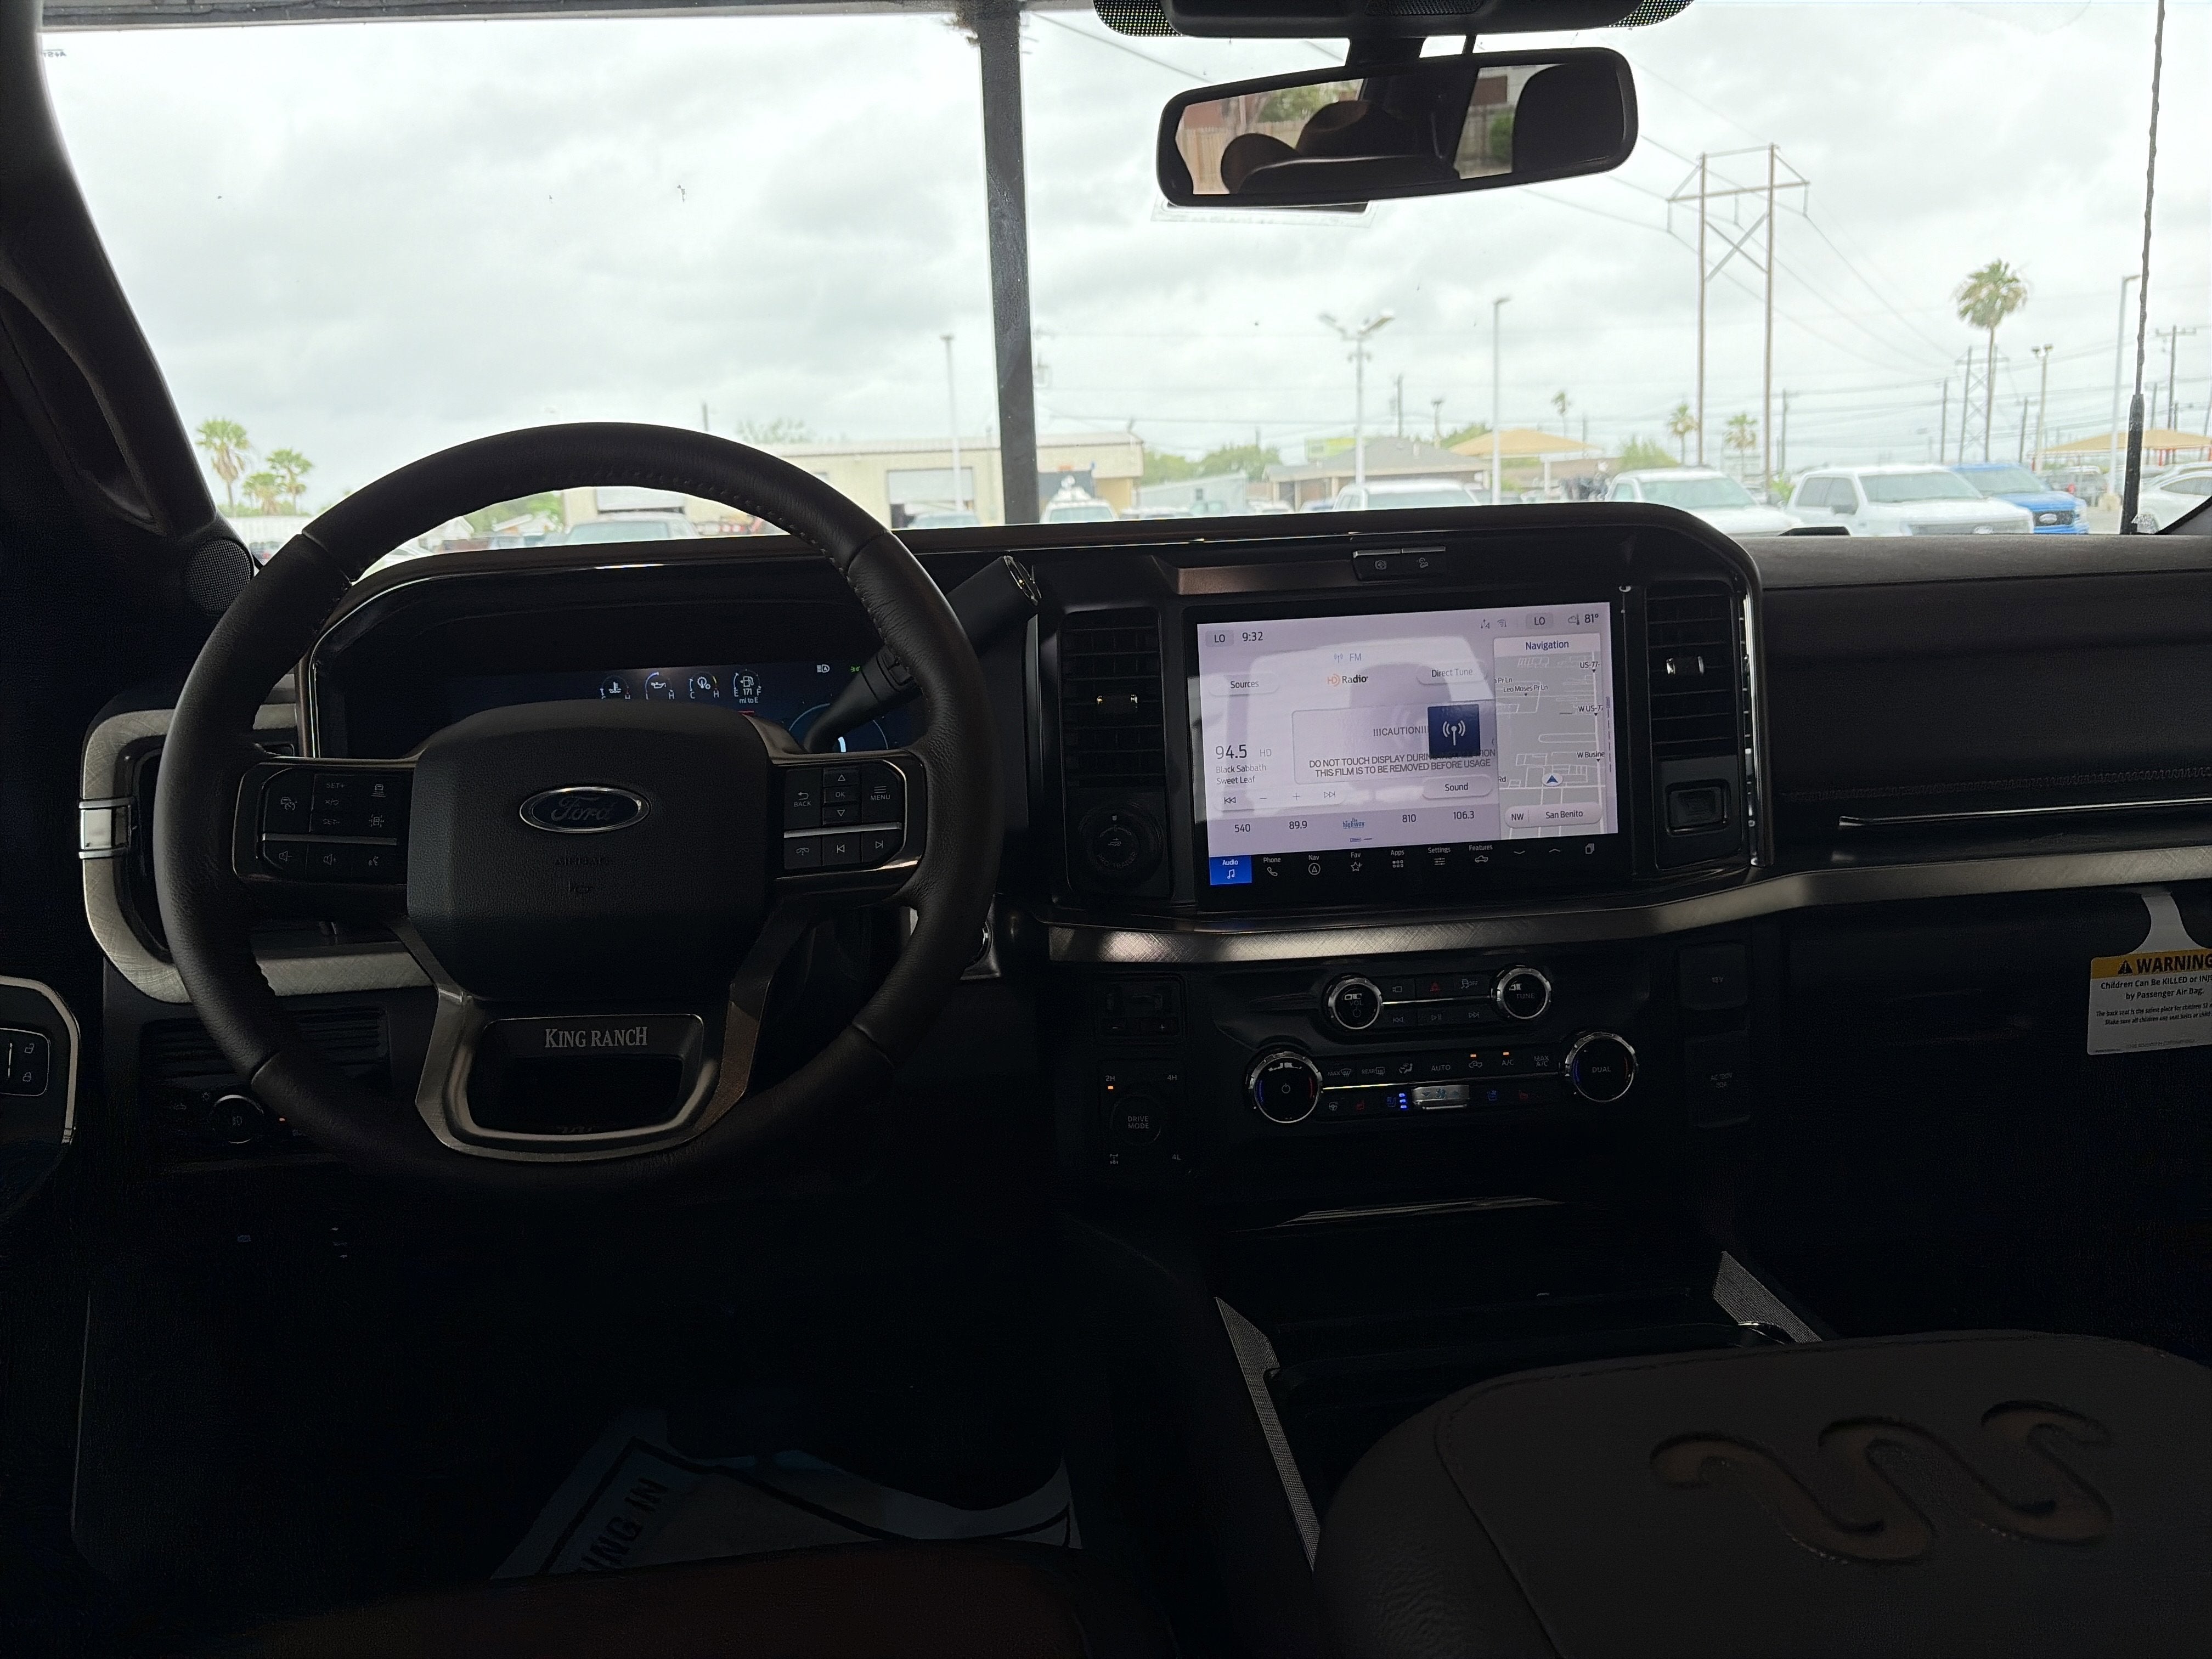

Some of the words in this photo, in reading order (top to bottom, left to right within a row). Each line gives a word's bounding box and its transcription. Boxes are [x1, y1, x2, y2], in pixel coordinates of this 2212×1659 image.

[1534, 617, 1545, 625] LO
[1584, 614, 1599, 623] 81°
[1214, 634, 1226, 643] LO
[1242, 632, 1263, 642] 9:32
[1525, 641, 1569, 650] Navigation
[1431, 669, 1453, 678] Direct
[1230, 680, 1259, 689] Sources
[742, 688, 753, 696] 171
[1215, 744, 1247, 759] 94.5
[1260, 748, 1272, 757] HD
[1309, 760, 1321, 768] DO
[1323, 759, 1339, 768] NOT
[1341, 757, 1370, 766] TOUCH
[1372, 754, 1405, 764] DISPLAY
[1407, 753, 1437, 763] DURIN
[1216, 765, 1235, 774] Black
[1237, 764, 1266, 773] Sabbath
[1315, 769, 1333, 777] THIS
[1334, 768, 1354, 776] FILM
[1356, 767, 1363, 775] IS
[1365, 766, 1376, 775] TO
[1378, 765, 1389, 774] BE
[1392, 763, 1430, 773] REMOVED
[1431, 760, 1464, 769] BEFORE
[1464, 759, 1491, 768] USAGE
[1216, 777, 1238, 785] Sweet
[1240, 776, 1255, 784] Leaf
[1444, 783, 1469, 791] Sound
[551, 796, 615, 821] Ford
[1402, 814, 1417, 823] 810
[1453, 811, 1475, 820] 106.3
[1560, 810, 1583, 819] Benito
[1234, 824, 1251, 833] 540
[1289, 821, 1307, 830] 89.9
[1427, 846, 1451, 854] Settings
[2137, 953, 2212, 974] WARNING
[2101, 981, 2133, 990] Children
[2163, 977, 2187, 985] KILLED
[2126, 992, 2135, 1001] by
[2137, 990, 2174, 999] Passenger
[545, 1028, 586, 1048] KING
[591, 1026, 648, 1047] RANCH
